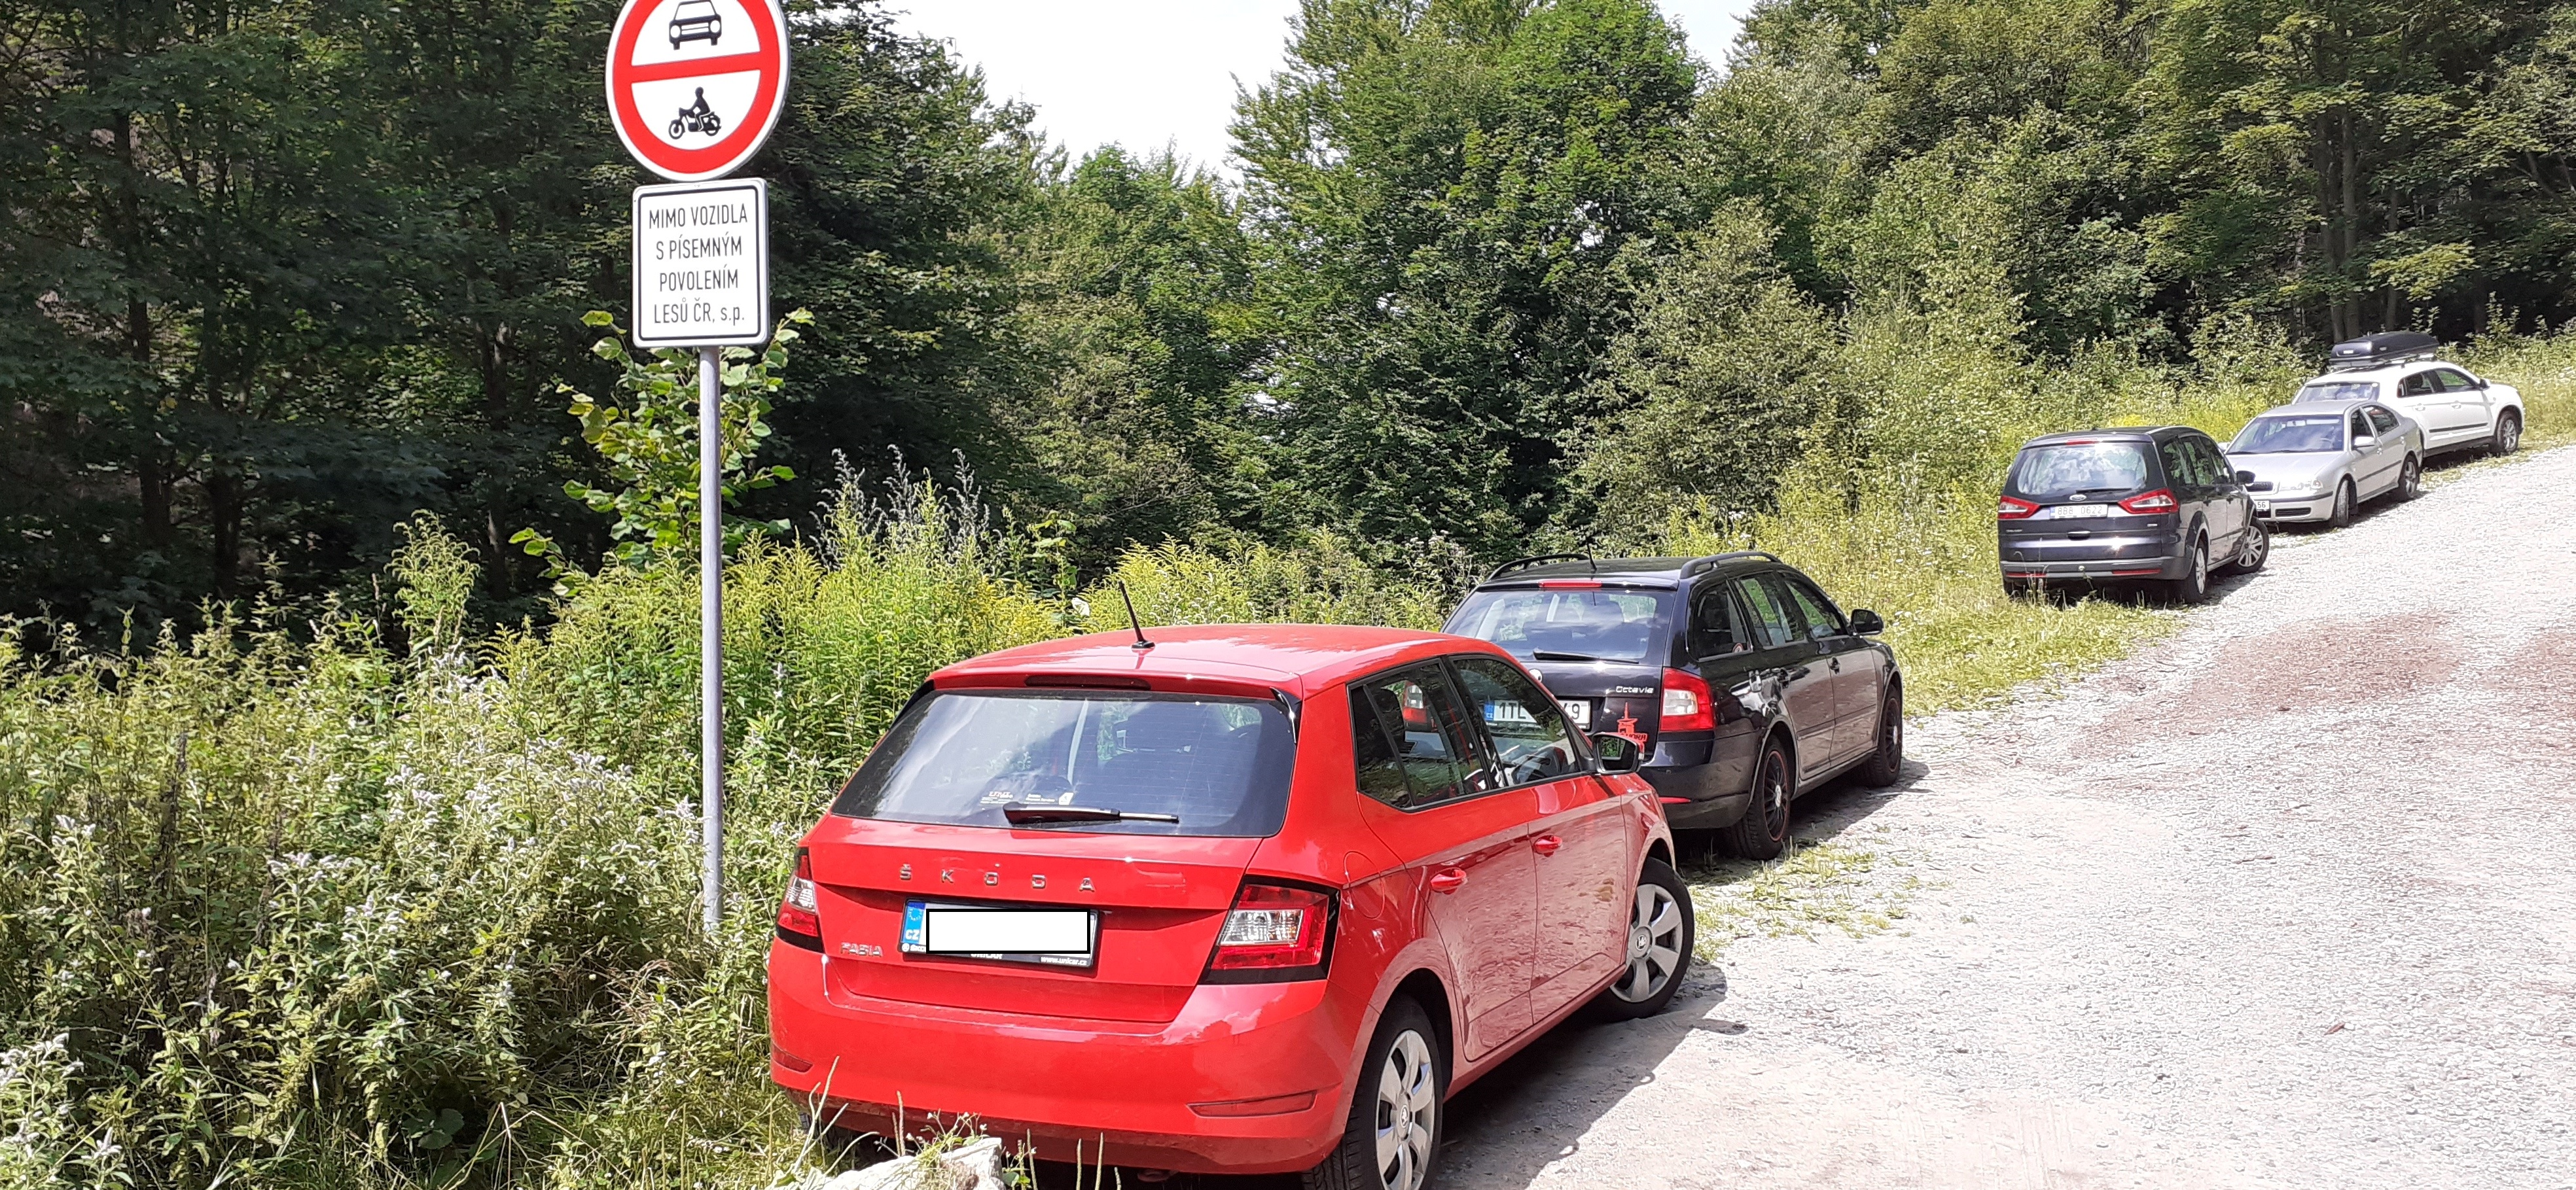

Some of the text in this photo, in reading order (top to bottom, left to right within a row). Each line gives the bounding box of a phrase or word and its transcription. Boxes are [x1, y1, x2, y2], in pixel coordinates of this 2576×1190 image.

[649, 203, 747, 229] MIMO VOZIDLA
[656, 231, 742, 260] S PÍSEMNÝM
[660, 264, 738, 292] POVOLENÍM
[654, 297, 745, 326] LESŮ ČR, s.p.
[2081, 506, 2102, 515] 0622
[1615, 686, 1655, 694] Octavia
[1499, 702, 1581, 720] 1TL 9
[899, 864, 1096, 892] ŠKODA
[905, 929, 920, 940] CZ
[840, 941, 884, 957] FABIA
